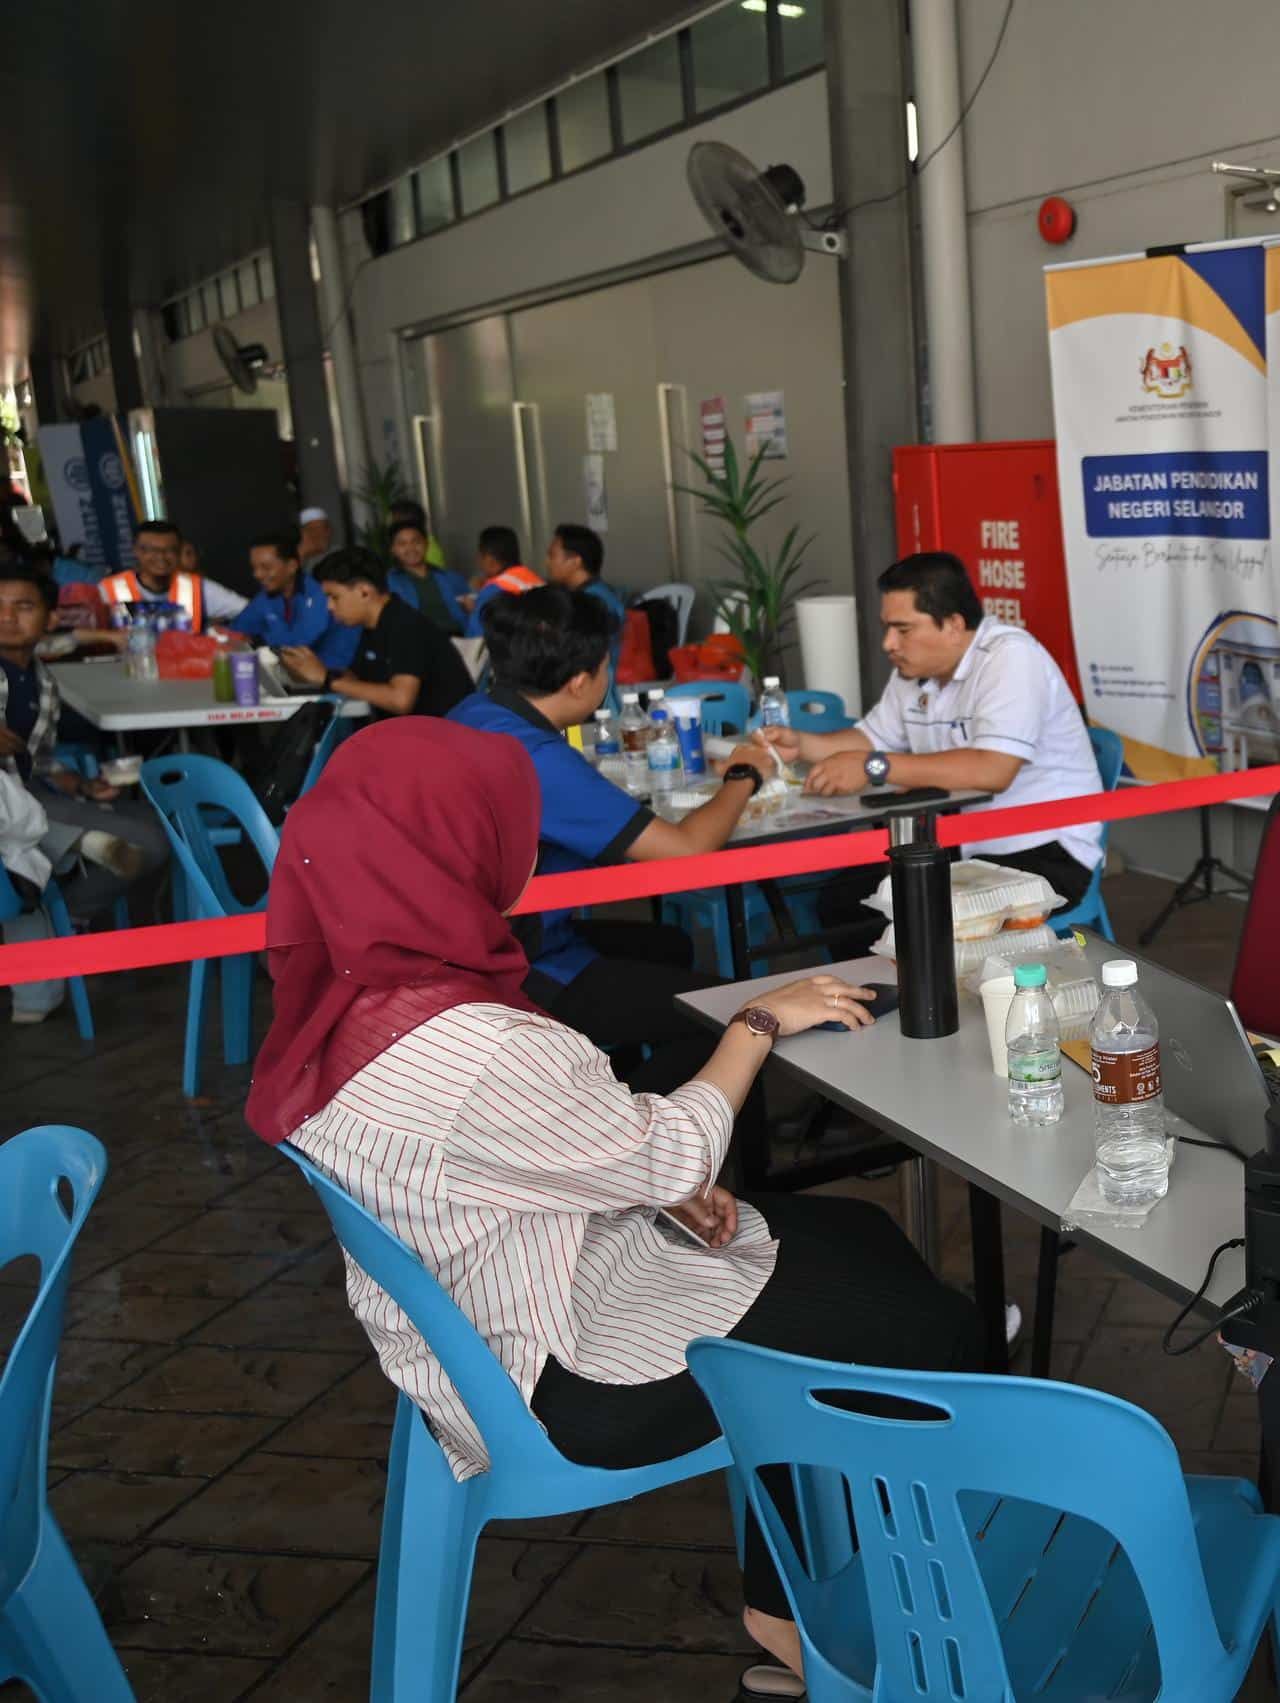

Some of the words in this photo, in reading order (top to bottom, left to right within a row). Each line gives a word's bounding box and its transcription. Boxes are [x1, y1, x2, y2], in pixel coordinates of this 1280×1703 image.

[1094, 473, 1167, 492] JABATAN
[1171, 472, 1258, 490] PENDIDIKAN
[1108, 501, 1171, 519] NEGERI
[1173, 500, 1245, 519] SELANGOR
[980, 520, 1020, 549] FIRE
[979, 560, 1026, 589] HOSE
[984, 598, 1026, 628] REEL
